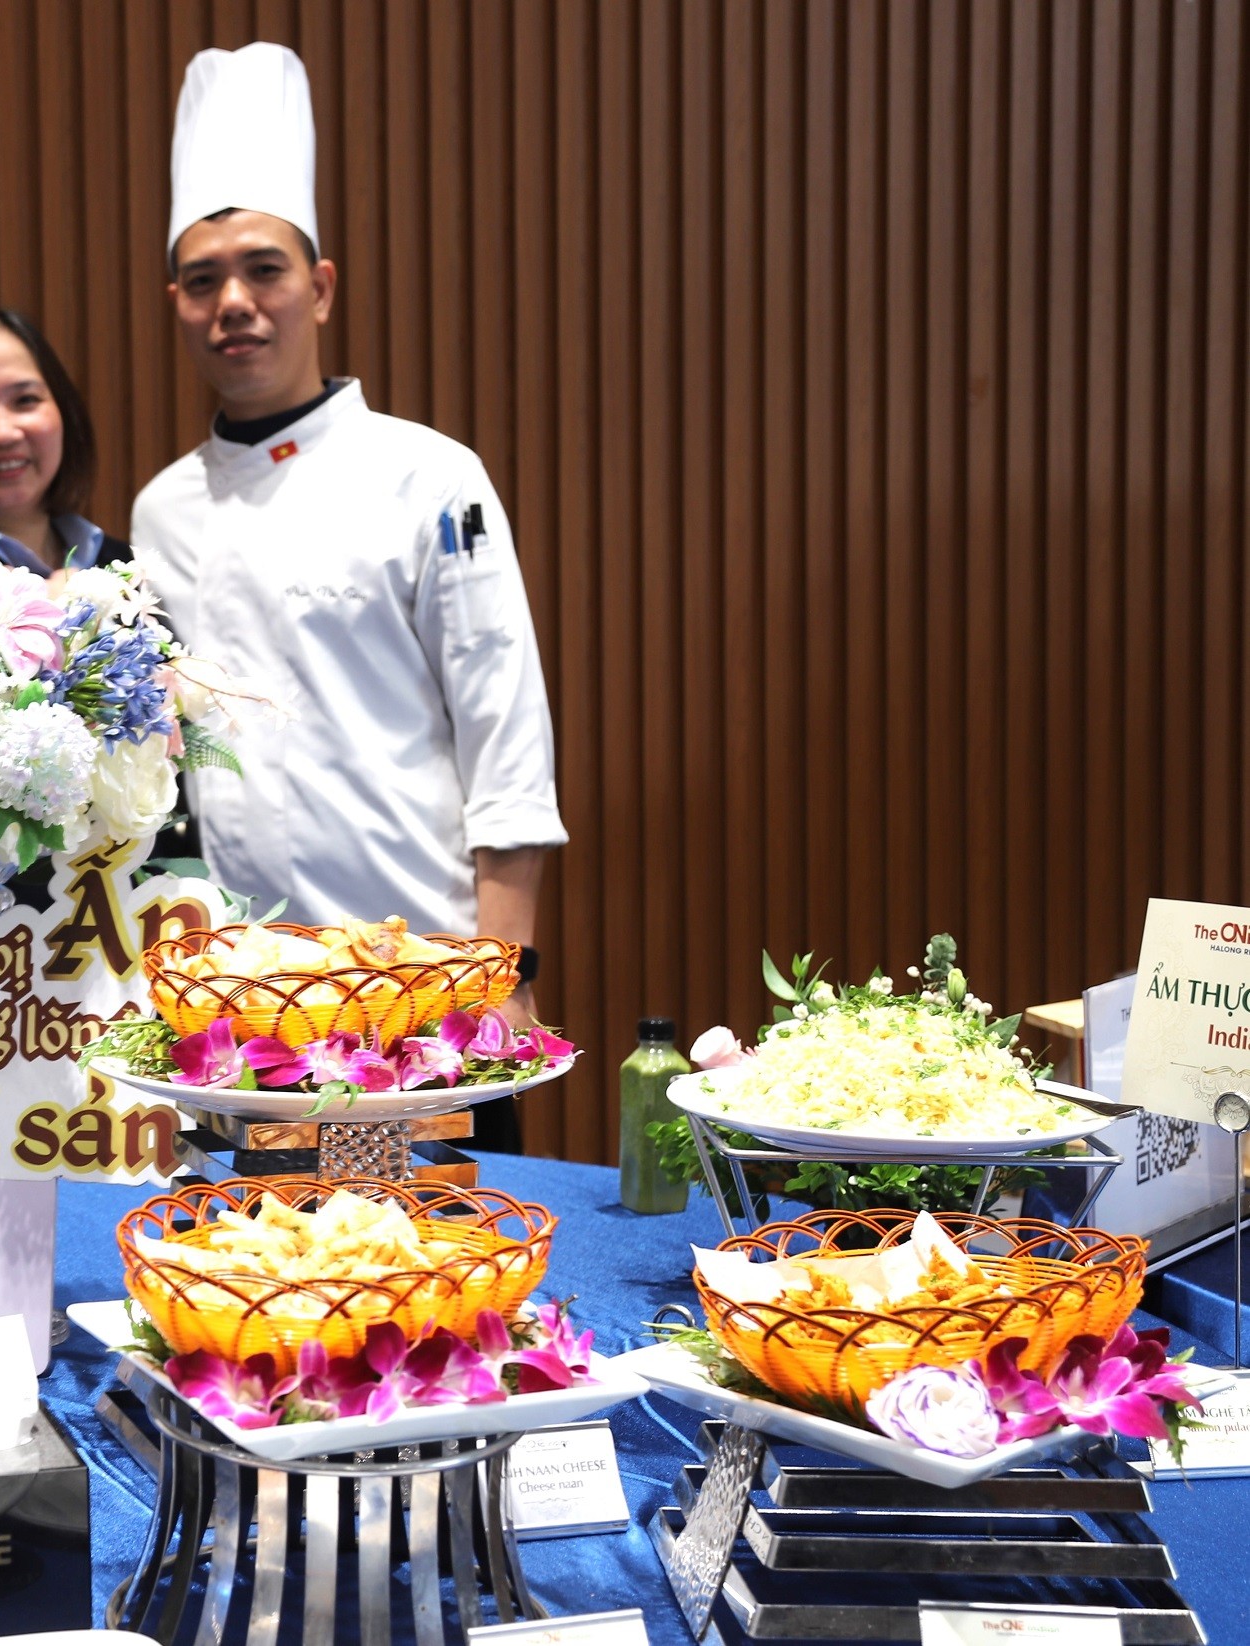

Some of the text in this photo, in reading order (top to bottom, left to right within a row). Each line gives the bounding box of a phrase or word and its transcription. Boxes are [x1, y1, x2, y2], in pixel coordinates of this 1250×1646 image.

[1194, 924, 1218, 940] The
[1210, 944, 1242, 954] HALONG
[1146, 962, 1180, 1001] ẨM
[20, 995, 141, 1063] lòn
[1208, 1024, 1250, 1050] Indi
[13, 1076, 183, 1178] sản
[526, 1464, 560, 1476] NAAN
[563, 1460, 607, 1473] CHEESE
[518, 1480, 584, 1493] Cheese naan
